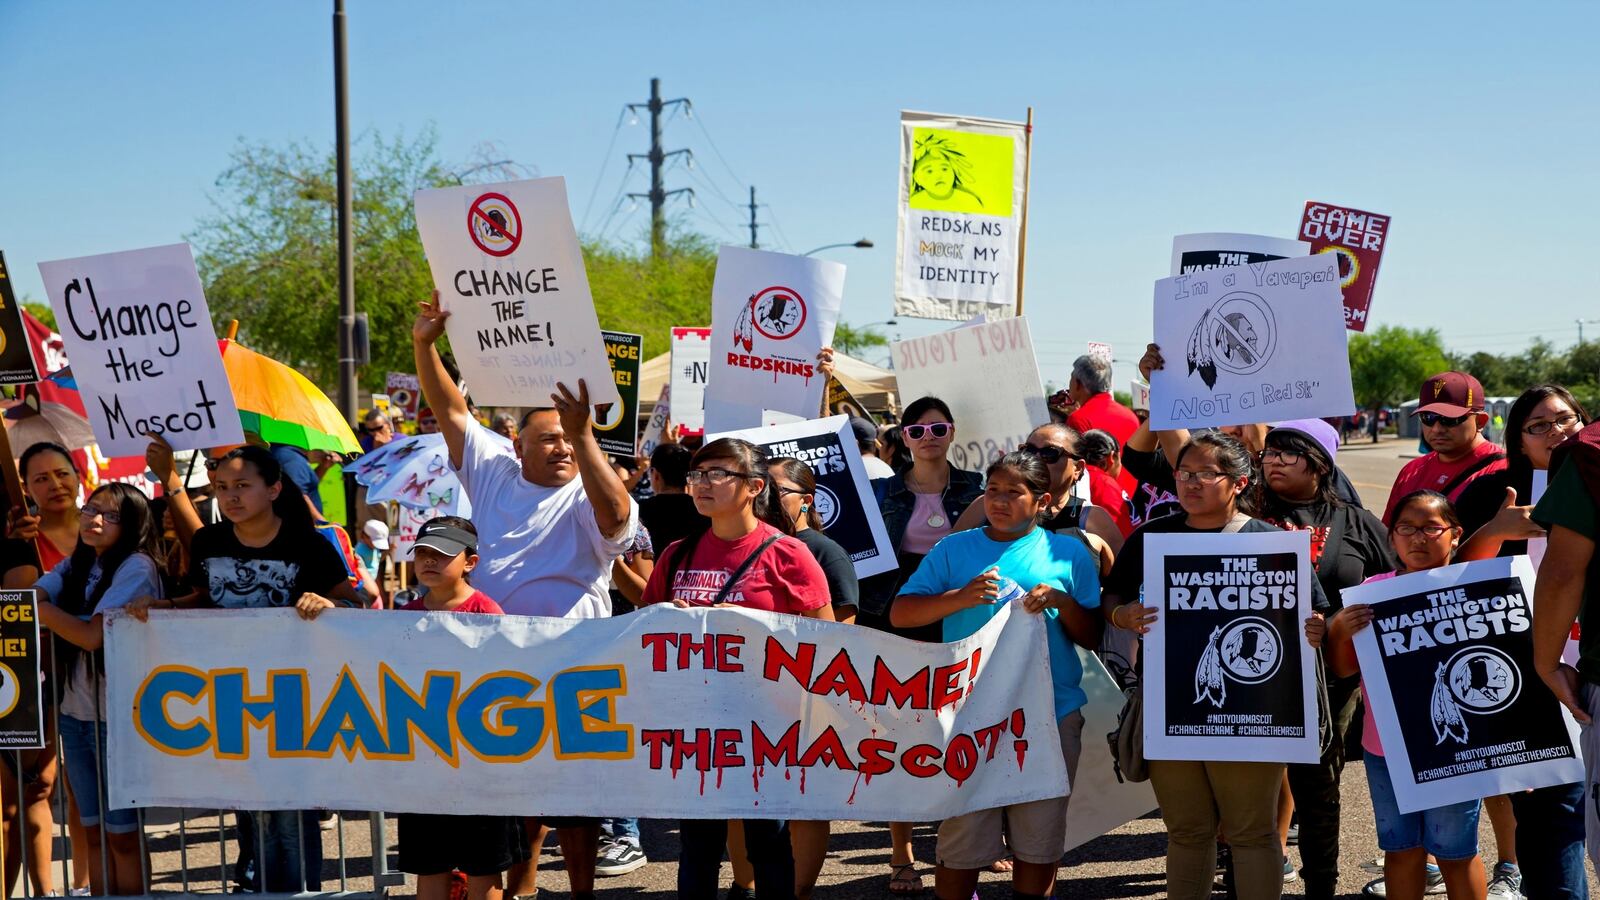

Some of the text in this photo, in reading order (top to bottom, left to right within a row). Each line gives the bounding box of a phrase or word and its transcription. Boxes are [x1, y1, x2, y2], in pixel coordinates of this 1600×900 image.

[921, 216, 1002, 237] REDSK_NS
[1308, 205, 1387, 236] GAME
[1304, 221, 1382, 252] OVER
[919, 240, 999, 261] MOCK MY
[1218, 252, 1249, 265] THE
[454, 267, 559, 297] CHANGE
[920, 265, 1000, 286] IDENTITY
[1222, 273, 1236, 288] a
[1249, 261, 1334, 290] Yavapai
[64, 277, 198, 357] Change
[491, 300, 526, 323] THE
[476, 321, 555, 352] NAME!
[605, 342, 639, 360] NGE
[105, 347, 164, 383] the
[727, 352, 814, 378] REDSKINS
[1239, 392, 1256, 410] a
[1261, 383, 1293, 405] Red
[98, 380, 217, 440] Mascot
[769, 441, 800, 456] THE
[1221, 557, 1258, 572] THE
[674, 569, 726, 589] CARDINALS
[1169, 570, 1296, 586] WASHINGTON
[1169, 585, 1297, 611] RACISTS
[1427, 588, 1467, 608] THE
[1378, 593, 1524, 633] WASHINGTON
[1381, 608, 1530, 657] RACISTS
[641, 632, 983, 711] THE NAME!
[133, 661, 635, 769] CHANGE
[1207, 714, 1273, 725] #NOTYOURMASCOT
[1168, 725, 1304, 737] #CHANGETHENAME #CHANGETHEMASCOT
[1455, 740, 1527, 763] #NOTYOURMASCOT
[1417, 758, 1488, 782] #CHANGETHENAME
